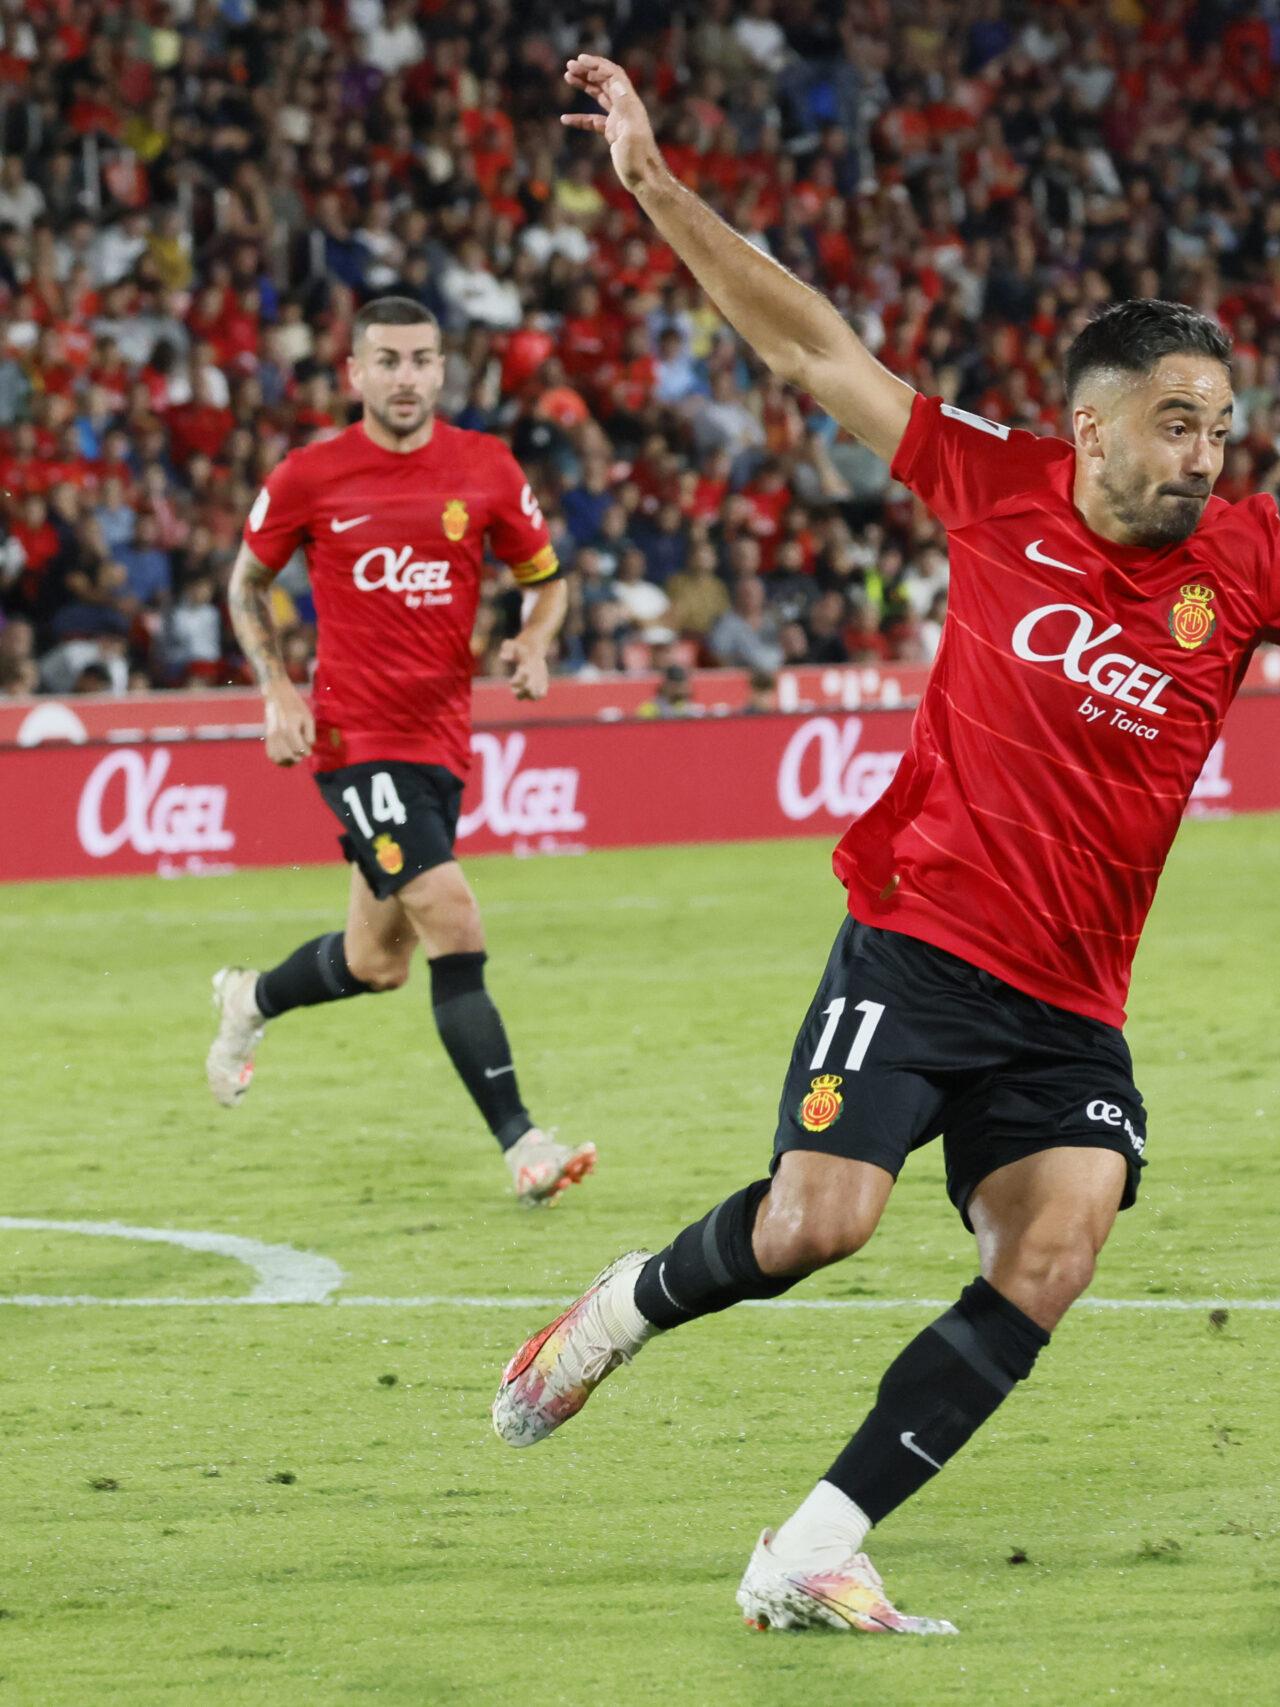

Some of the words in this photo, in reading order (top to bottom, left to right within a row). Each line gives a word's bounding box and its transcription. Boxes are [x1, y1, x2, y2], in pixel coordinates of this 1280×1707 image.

[1077, 695, 1106, 723] by
[1109, 708, 1160, 741] Taica
[342, 771, 408, 839] 14
[809, 996, 886, 1072] 11
